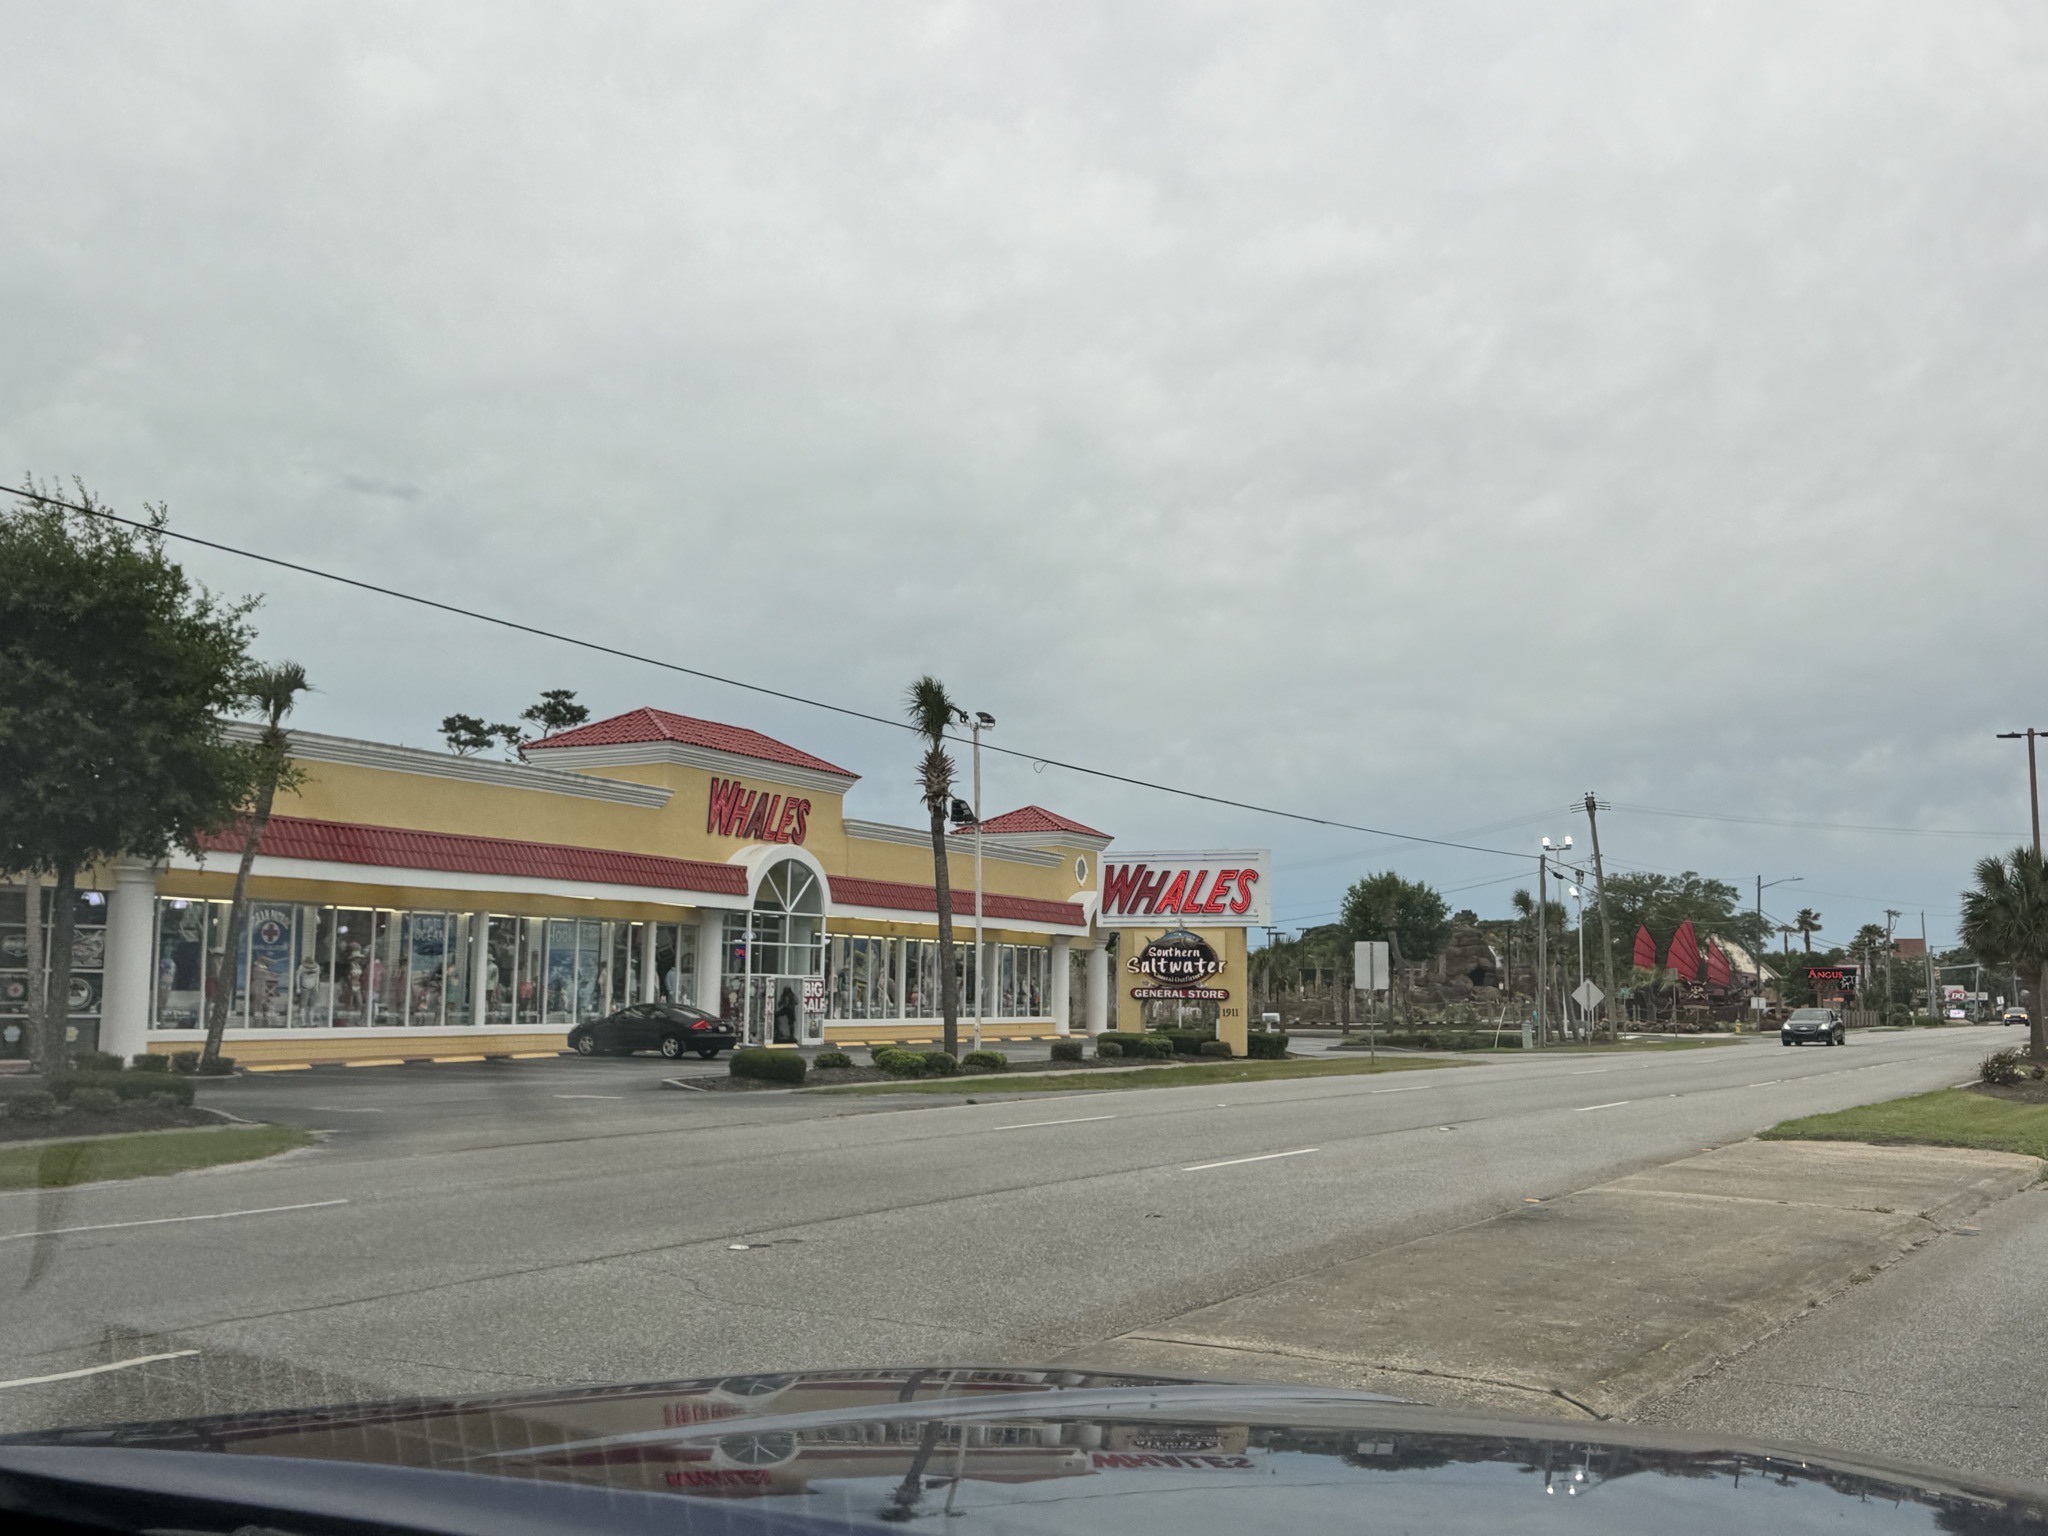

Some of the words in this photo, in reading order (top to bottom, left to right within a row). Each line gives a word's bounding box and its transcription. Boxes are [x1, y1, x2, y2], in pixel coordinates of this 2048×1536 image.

[707, 776, 811, 845] WHALES
[1101, 864, 1259, 914] WHALES
[1148, 946, 1200, 958] Southern
[1126, 957, 1228, 974] Saltwater
[1808, 968, 1844, 979] ANGUS
[804, 982, 823, 997] BIG
[1134, 989, 1185, 998] GENERAL
[1188, 990, 1226, 999] STORE
[1951, 992, 1965, 1000] DQ
[803, 998, 826, 1013] SALE
[1222, 1008, 1239, 1017] 1911
